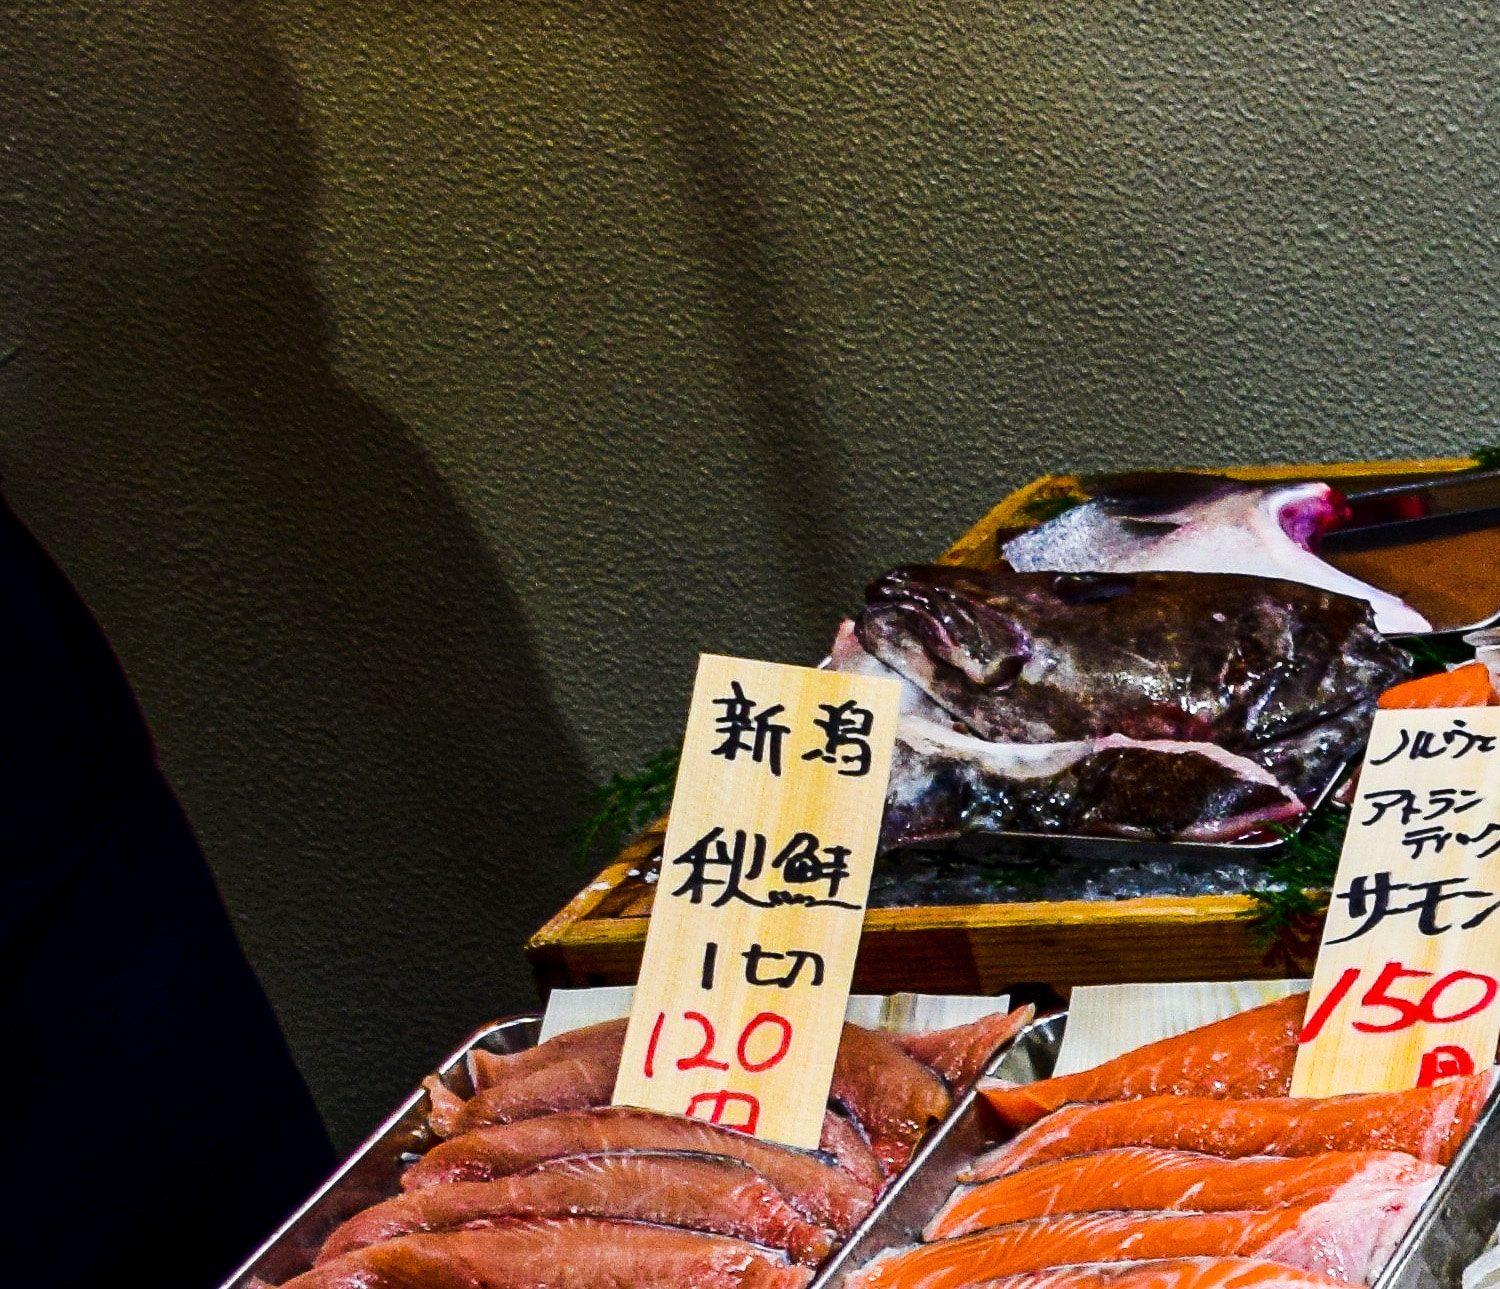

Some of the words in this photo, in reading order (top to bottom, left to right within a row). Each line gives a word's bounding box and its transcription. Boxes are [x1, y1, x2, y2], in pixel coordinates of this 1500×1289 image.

[711, 681, 873, 777] 新潟
[1362, 788, 1484, 826] アトラン
[672, 827, 863, 910] 秋鮭
[702, 942, 824, 989] 1切
[1300, 962, 1499, 1044] 150
[644, 1011, 793, 1078] 120
